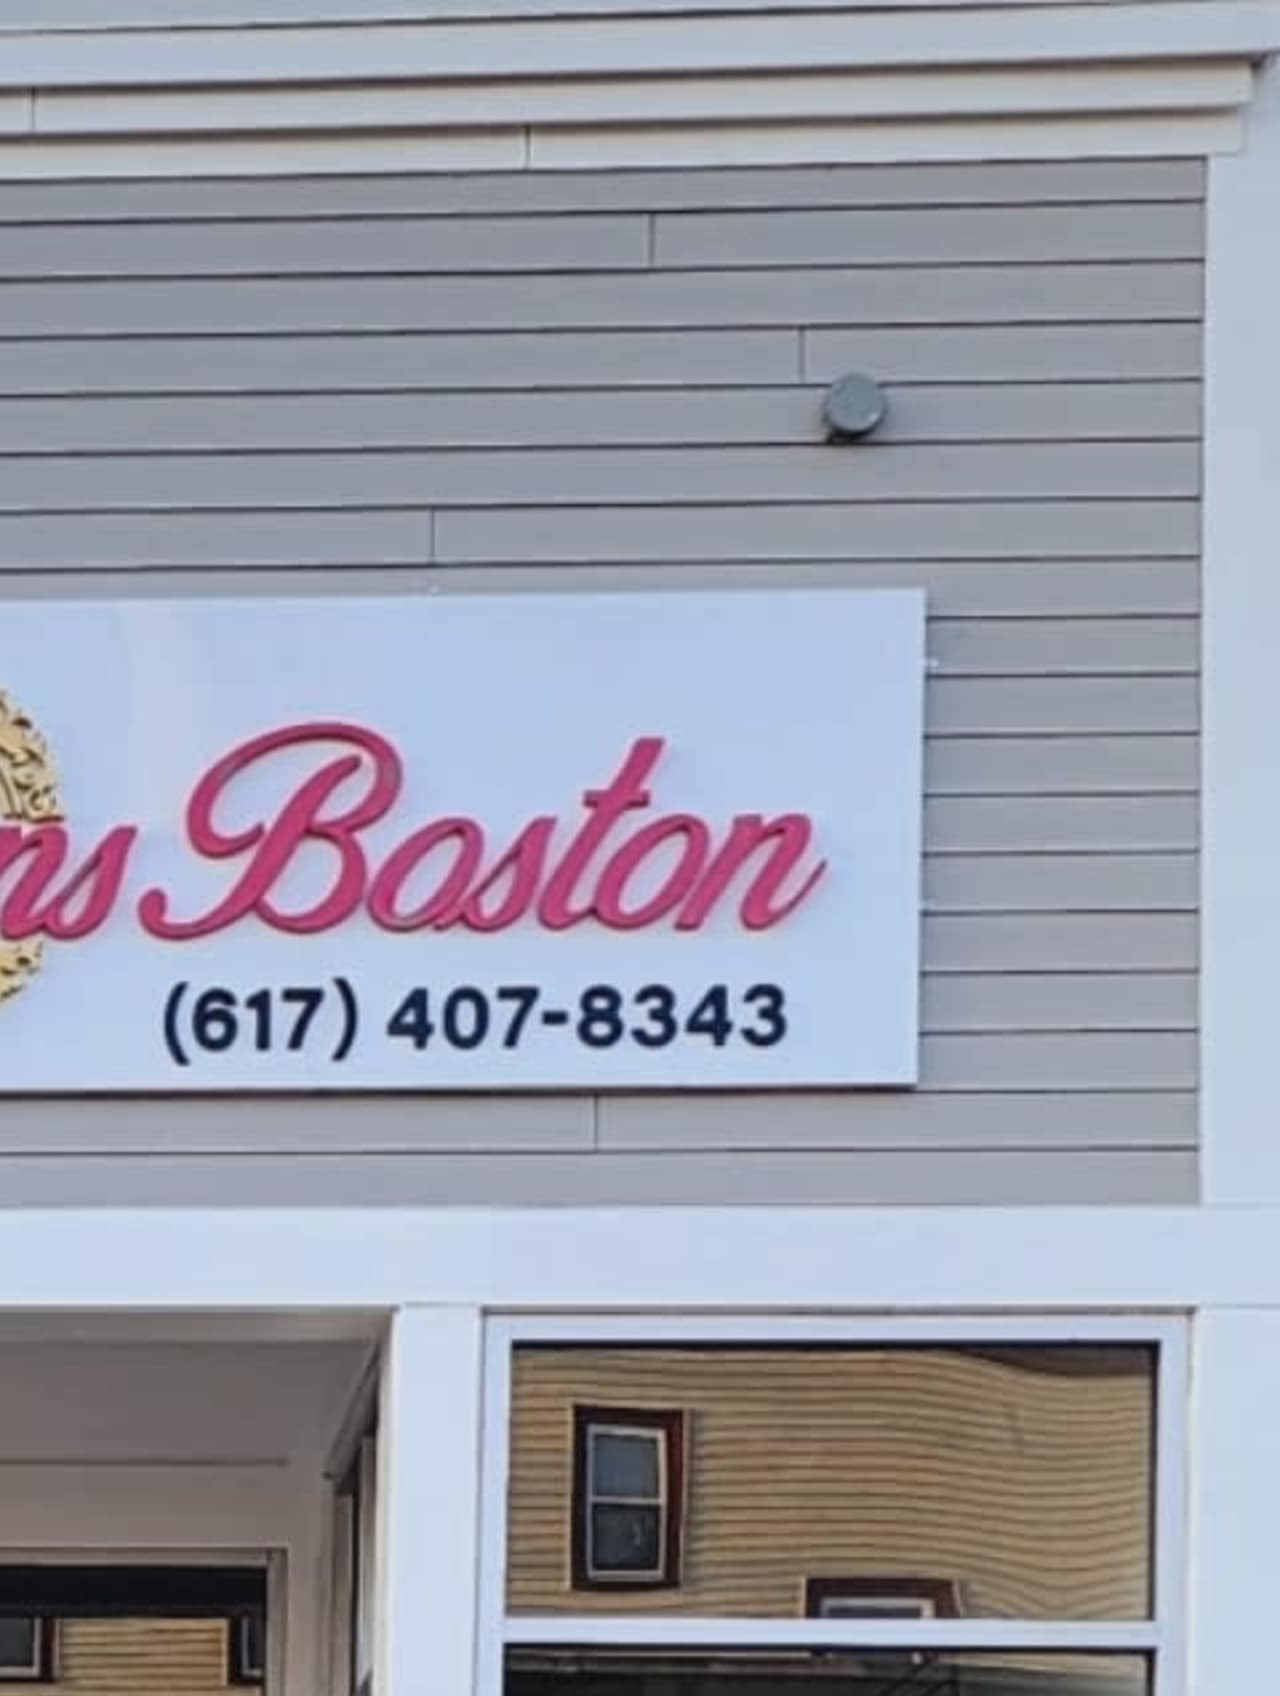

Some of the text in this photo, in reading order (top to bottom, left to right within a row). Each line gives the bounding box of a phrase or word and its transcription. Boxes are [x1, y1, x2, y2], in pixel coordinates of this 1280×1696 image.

[137, 723, 826, 940] Boston
[163, 977, 788, 1066] (617) 407-8343
